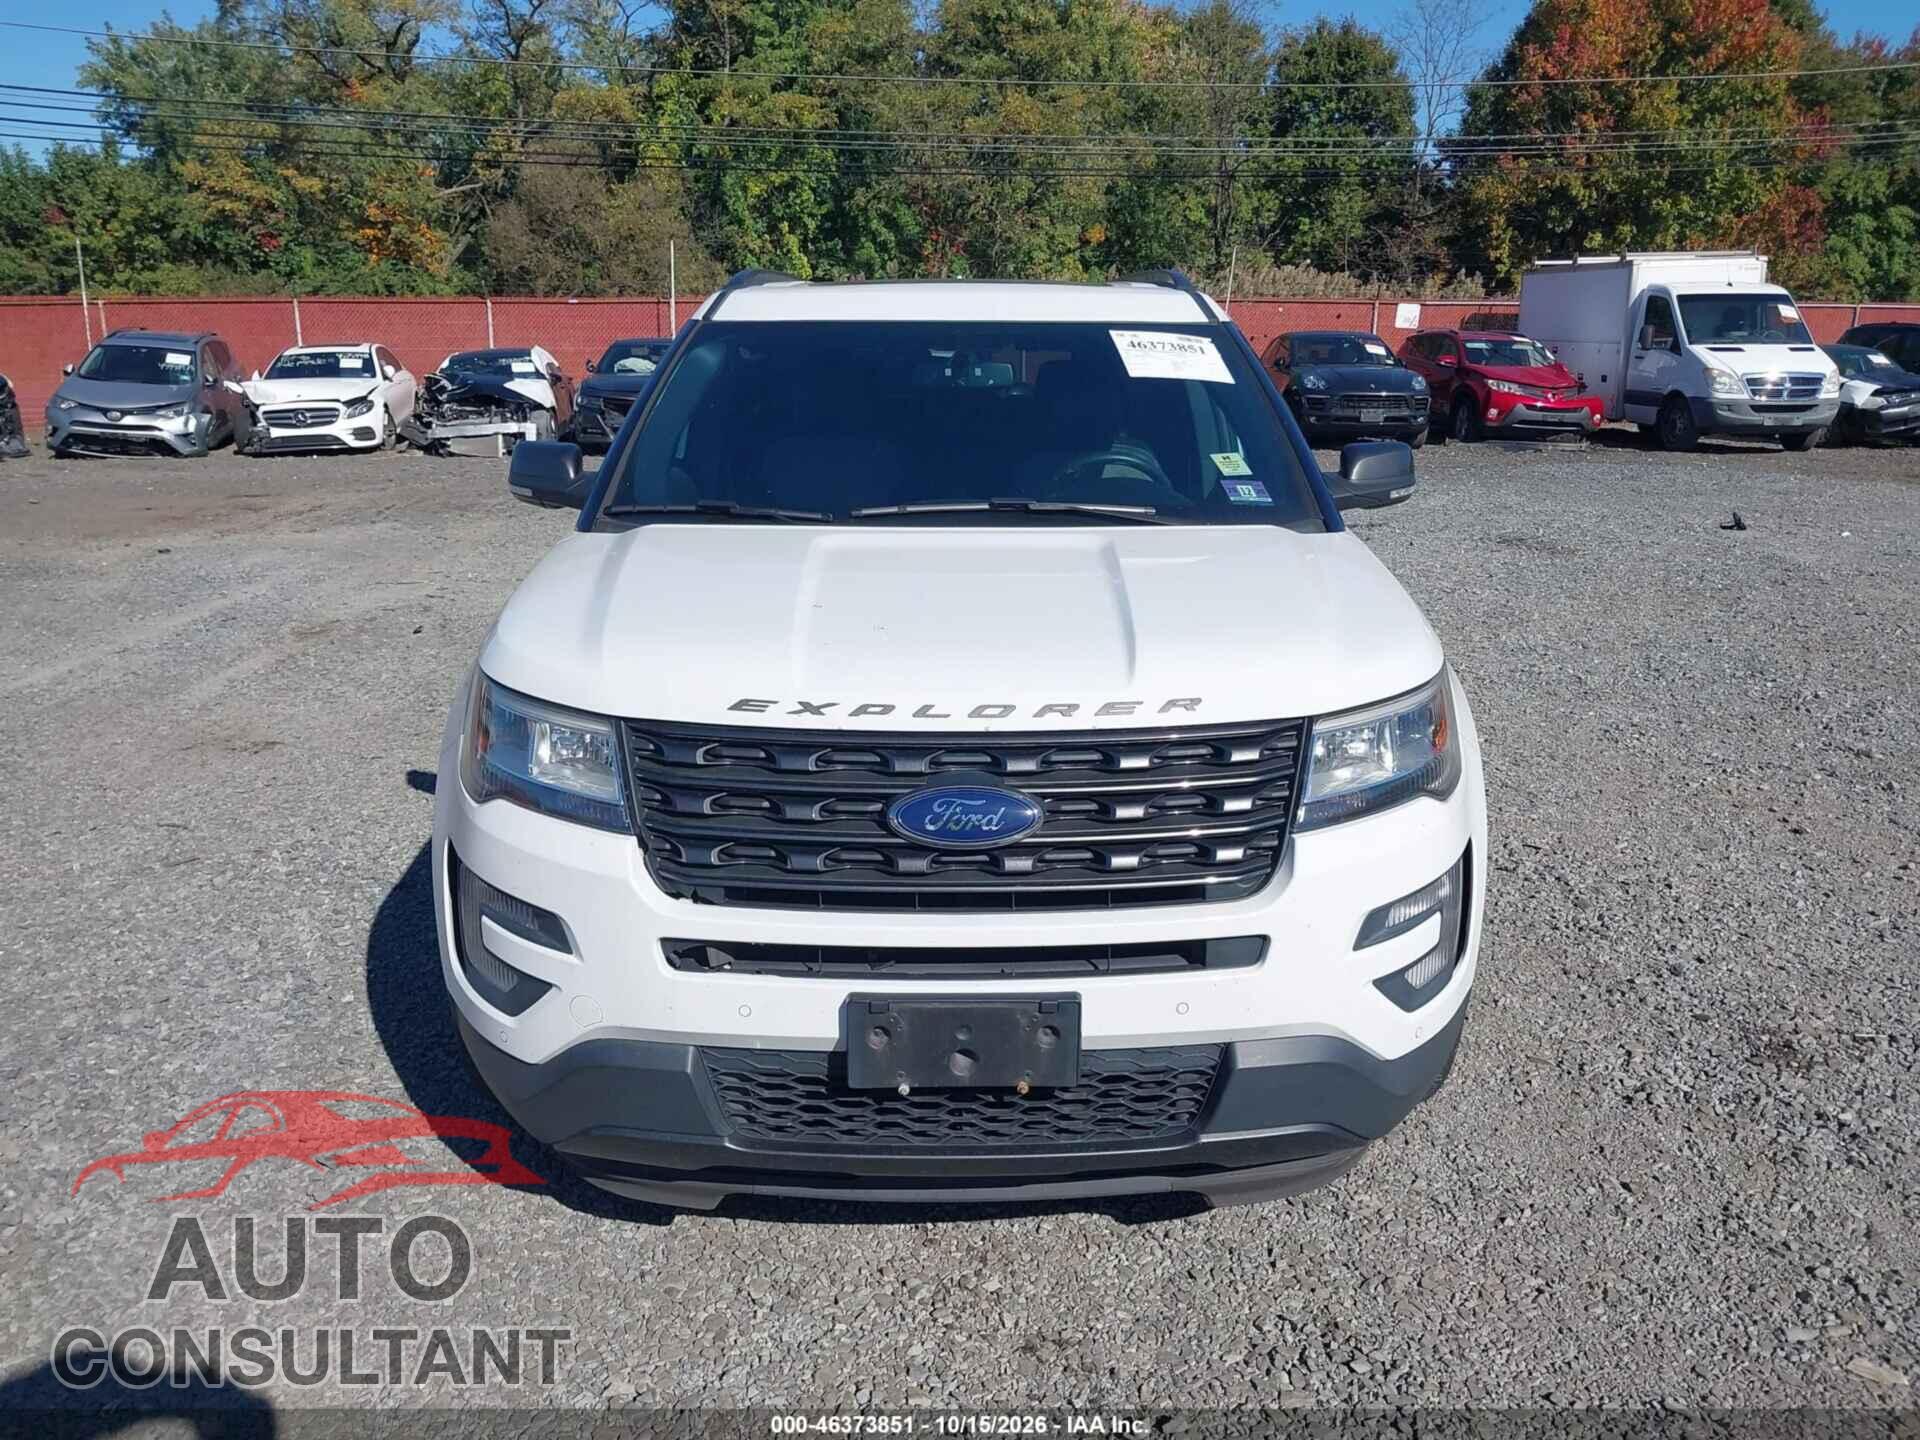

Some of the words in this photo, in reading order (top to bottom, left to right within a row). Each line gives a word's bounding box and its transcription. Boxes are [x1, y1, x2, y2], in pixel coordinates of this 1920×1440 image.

[1126, 340, 1206, 355] 46373851
[726, 697, 1203, 719] EXPLORER
[923, 797, 1006, 832] Ford
